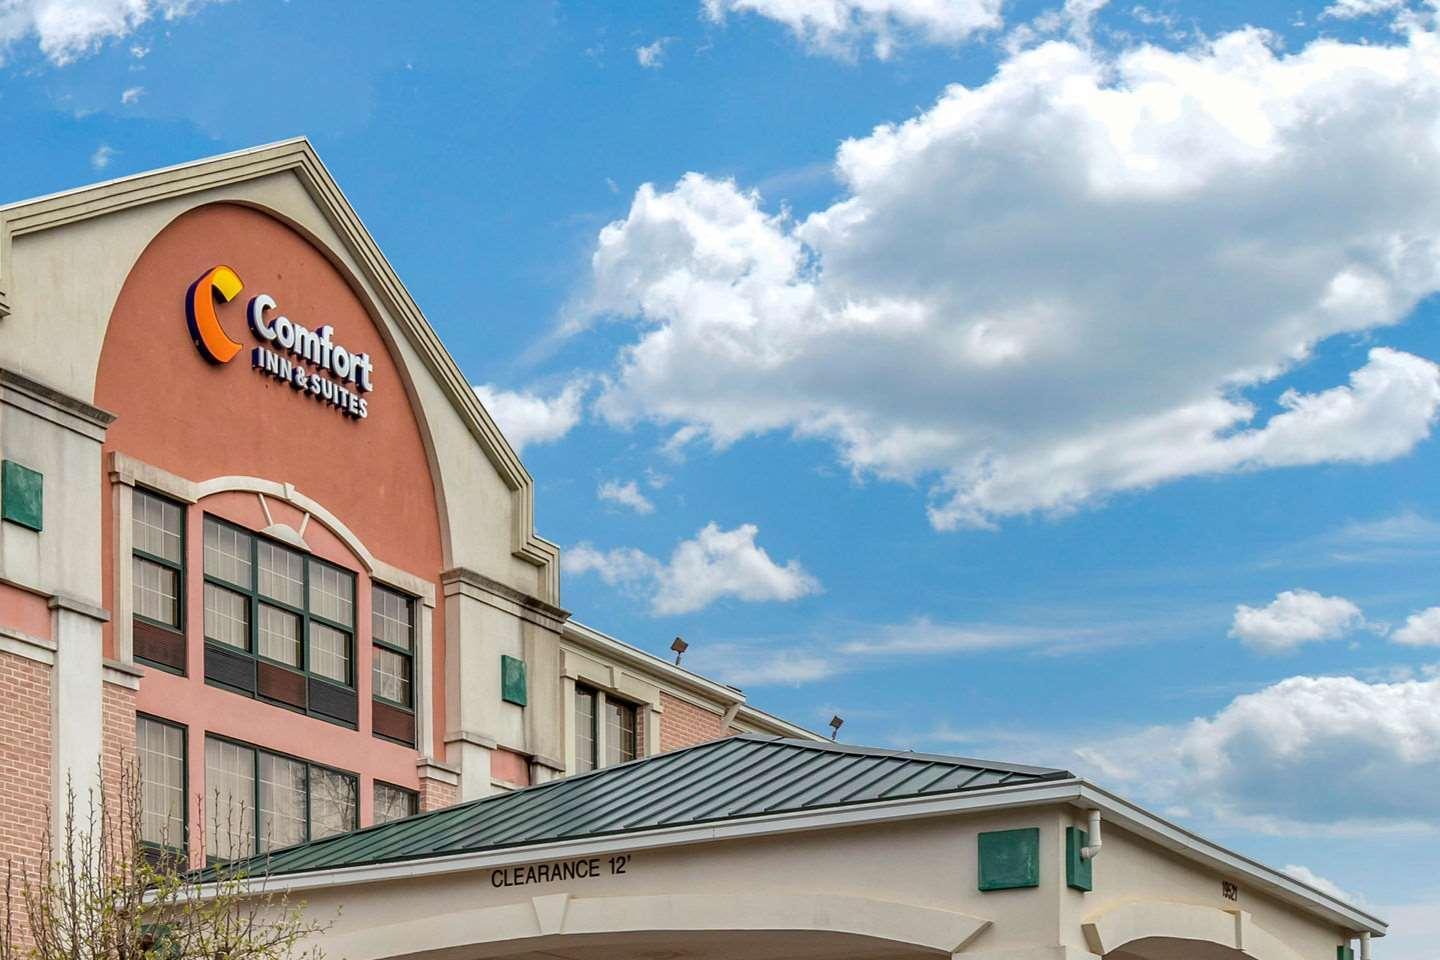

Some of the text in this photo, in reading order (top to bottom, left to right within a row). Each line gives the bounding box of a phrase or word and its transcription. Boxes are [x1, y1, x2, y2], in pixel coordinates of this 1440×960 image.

[248, 294, 373, 392] Comfort
[252, 345, 368, 419] INN & SUITES
[491, 858, 600, 888] CLEARANCE
